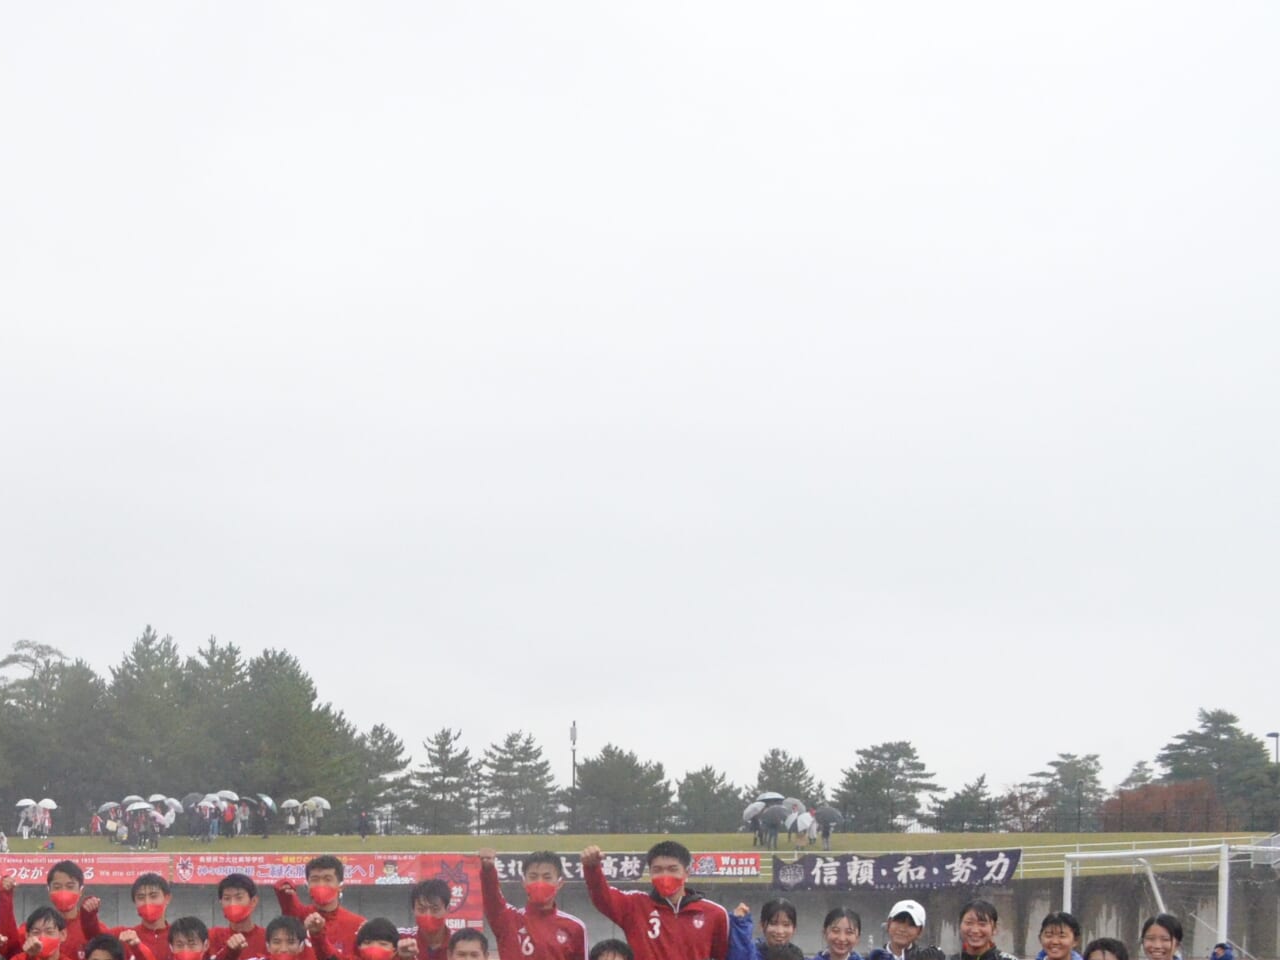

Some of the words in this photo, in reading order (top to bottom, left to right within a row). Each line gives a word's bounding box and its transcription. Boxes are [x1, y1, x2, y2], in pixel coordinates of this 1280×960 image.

[720, 855, 736, 865] We
[738, 857, 756, 865] are
[720, 866, 757, 876] TAISHA
[811, 853, 1010, 886] 信頼・和・努力
[647, 917, 661, 939] 3
